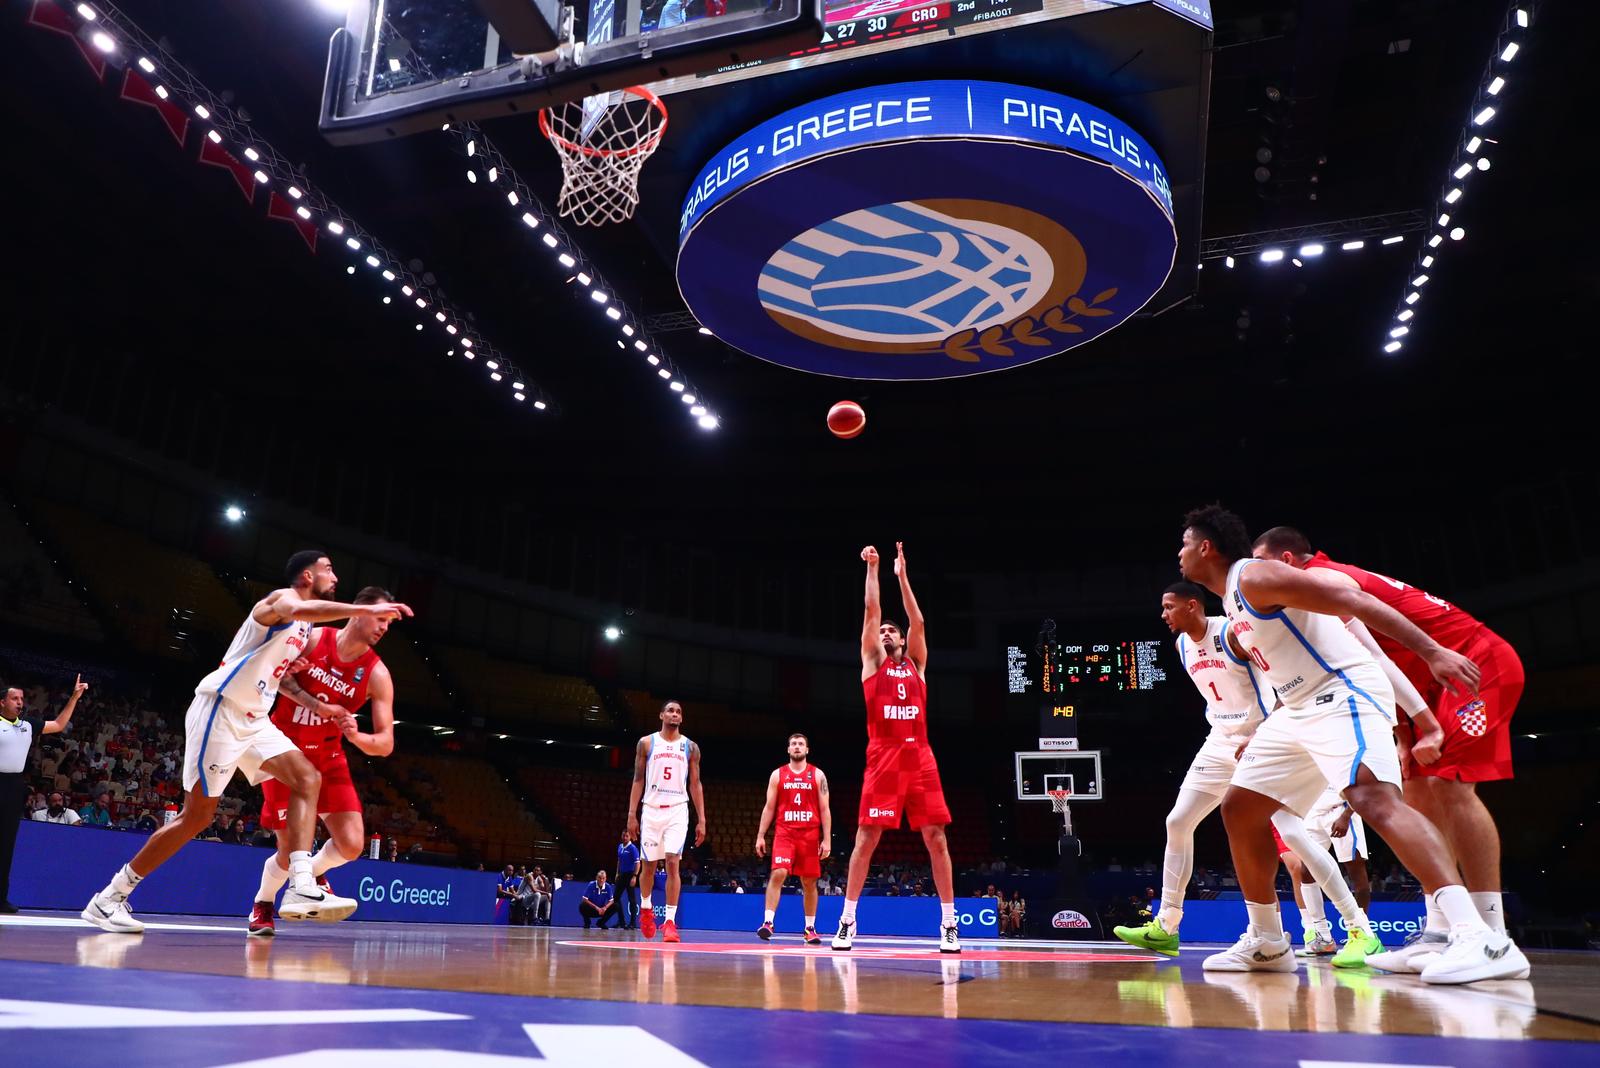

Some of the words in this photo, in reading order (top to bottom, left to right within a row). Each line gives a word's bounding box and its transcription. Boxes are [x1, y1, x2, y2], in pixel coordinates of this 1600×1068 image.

[957, 1, 975, 12] 2nd
[911, 7, 938, 22] CRO
[837, 22, 857, 39] 27
[867, 16, 887, 33] 30
[772, 96, 932, 156] GREECE
[1003, 97, 1142, 168] PIRAEUS
[1065, 645, 1082, 653] DOM
[1092, 644, 1109, 652] CRO
[1068, 667, 1079, 675] 27
[1100, 665, 1111, 674] 30
[308, 664, 356, 699] HRVATSKA
[897, 683, 907, 700] 9
[1208, 681, 1223, 702] 1
[897, 705, 919, 720] HEP
[663, 766, 673, 781] 5
[783, 782, 813, 790] HRVATSKA
[793, 792, 802, 806] 4
[792, 811, 813, 822] HEP
[878, 808, 895, 818] HPB
[359, 876, 385, 902] Go
[389, 879, 451, 906] Greece!
